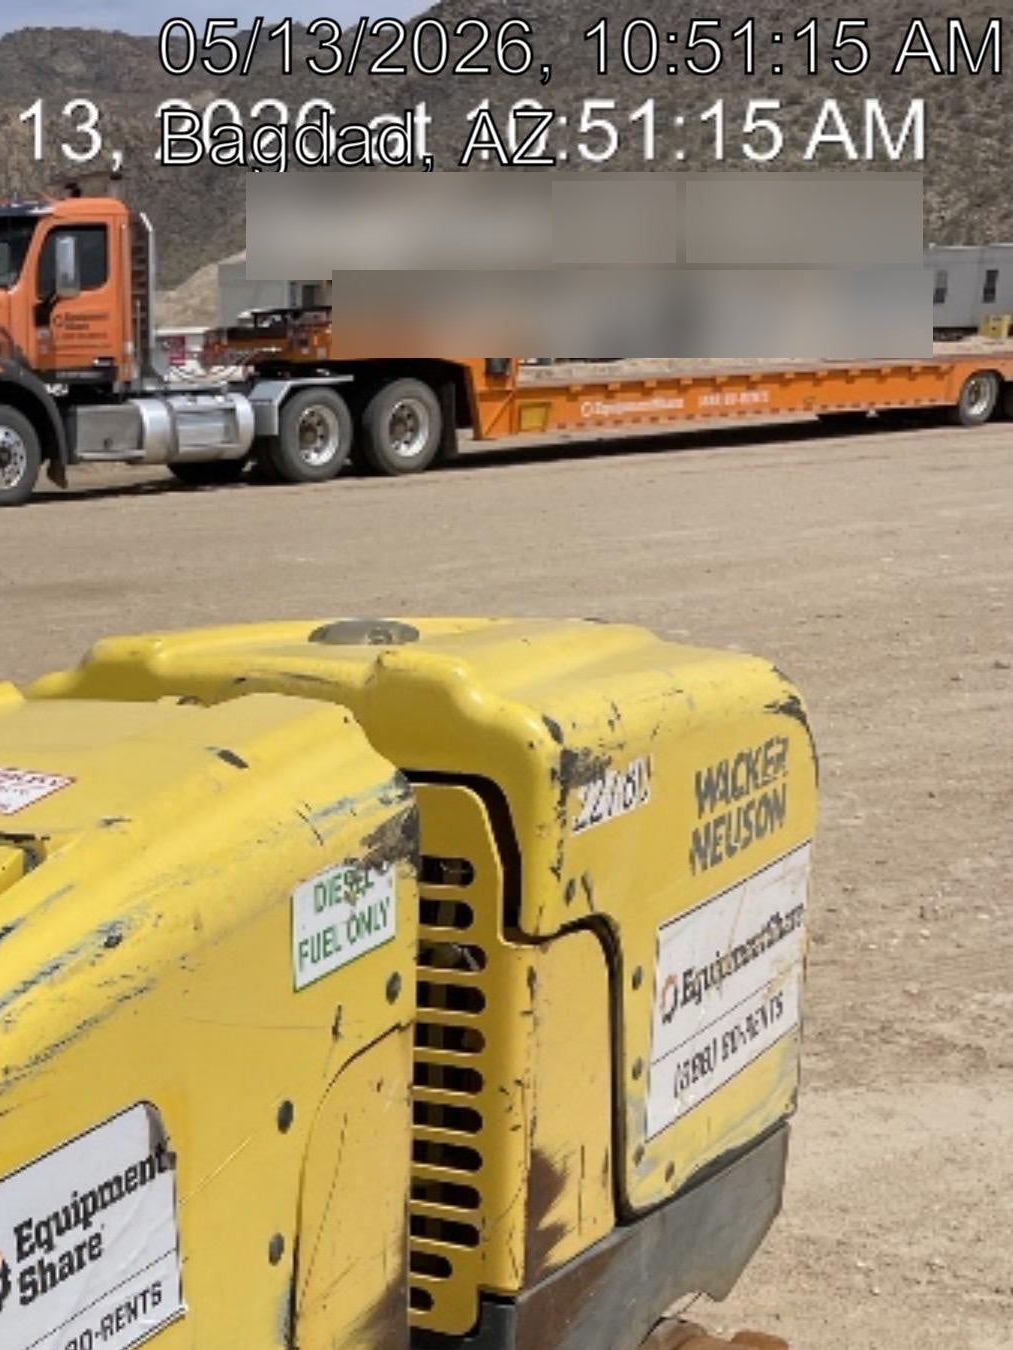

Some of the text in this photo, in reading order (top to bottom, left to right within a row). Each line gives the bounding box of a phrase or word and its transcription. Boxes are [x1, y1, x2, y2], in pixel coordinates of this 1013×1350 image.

[694, 736, 788, 820] WACKER
[689, 783, 786, 877] NEUSON
[313, 867, 375, 913] DIESEL
[298, 896, 390, 972] FUEL ONLY
[13, 1142, 175, 1264] Equipment
[19, 1232, 102, 1307] Share
